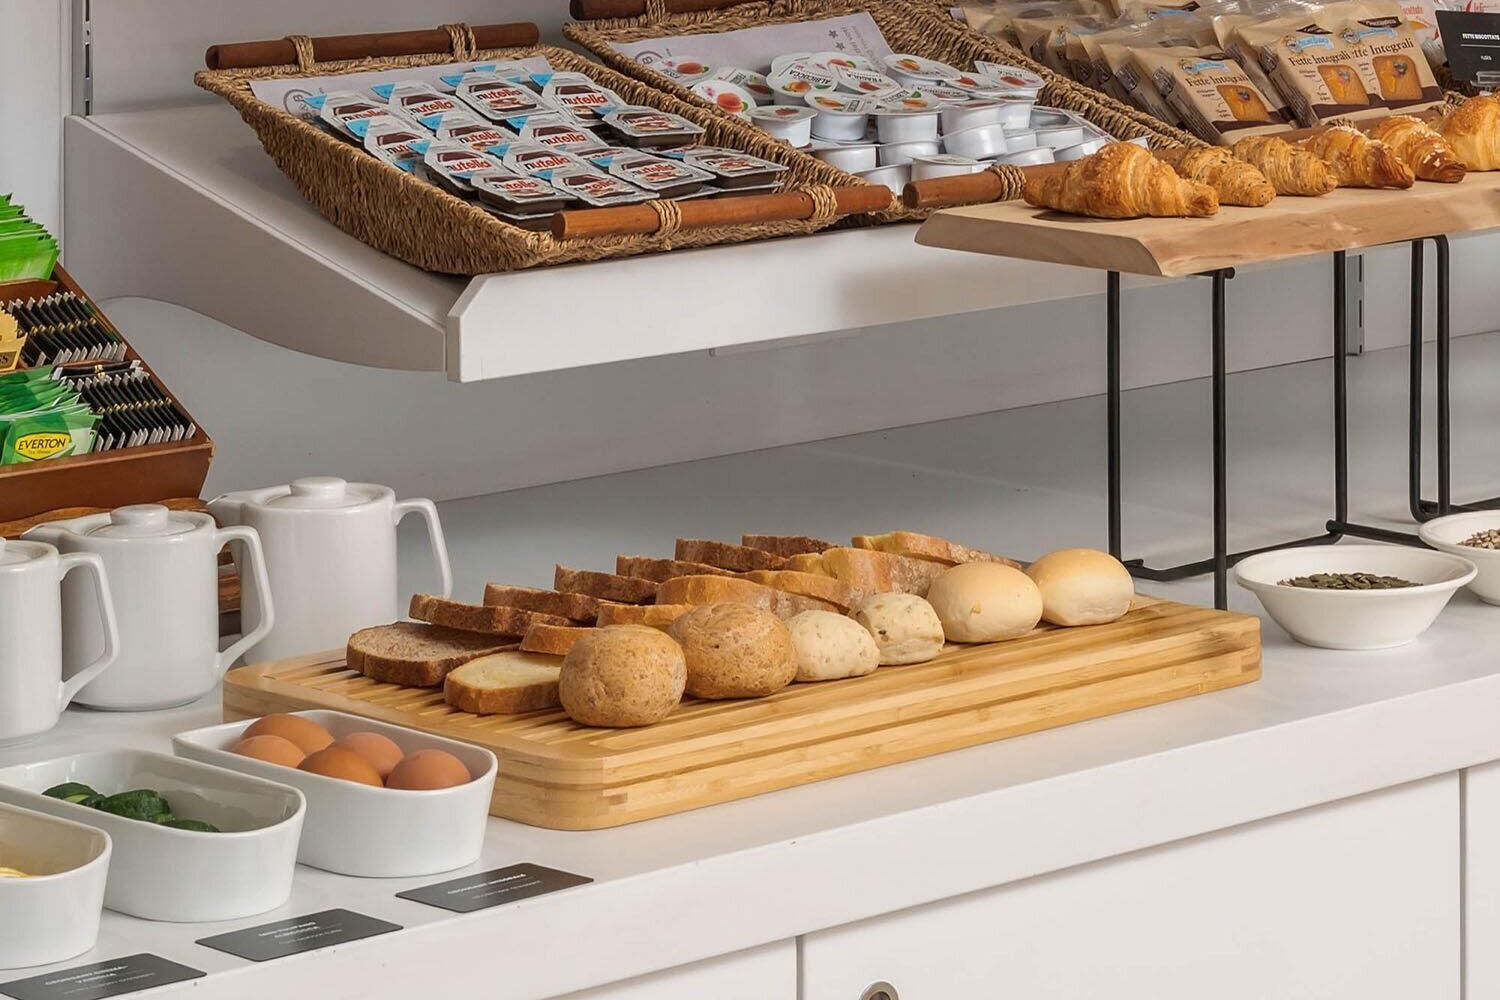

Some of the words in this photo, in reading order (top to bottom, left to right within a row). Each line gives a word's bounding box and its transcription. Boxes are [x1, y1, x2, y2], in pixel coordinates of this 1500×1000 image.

[1369, 38, 1414, 56] Integrali
[1288, 55, 1312, 66] Fette
[1312, 49, 1351, 64] Integrali
[1185, 77, 1211, 87] Fette
[1209, 73, 1250, 85] Integrali
[476, 88, 523, 101] nutella
[562, 95, 608, 105] nutella
[409, 99, 455, 115] nutella
[458, 131, 504, 144] nutella
[540, 133, 586, 145] nutella
[446, 160, 492, 172] nutella
[525, 156, 570, 170] nutella
[18, 438, 66, 451] EVERTON
